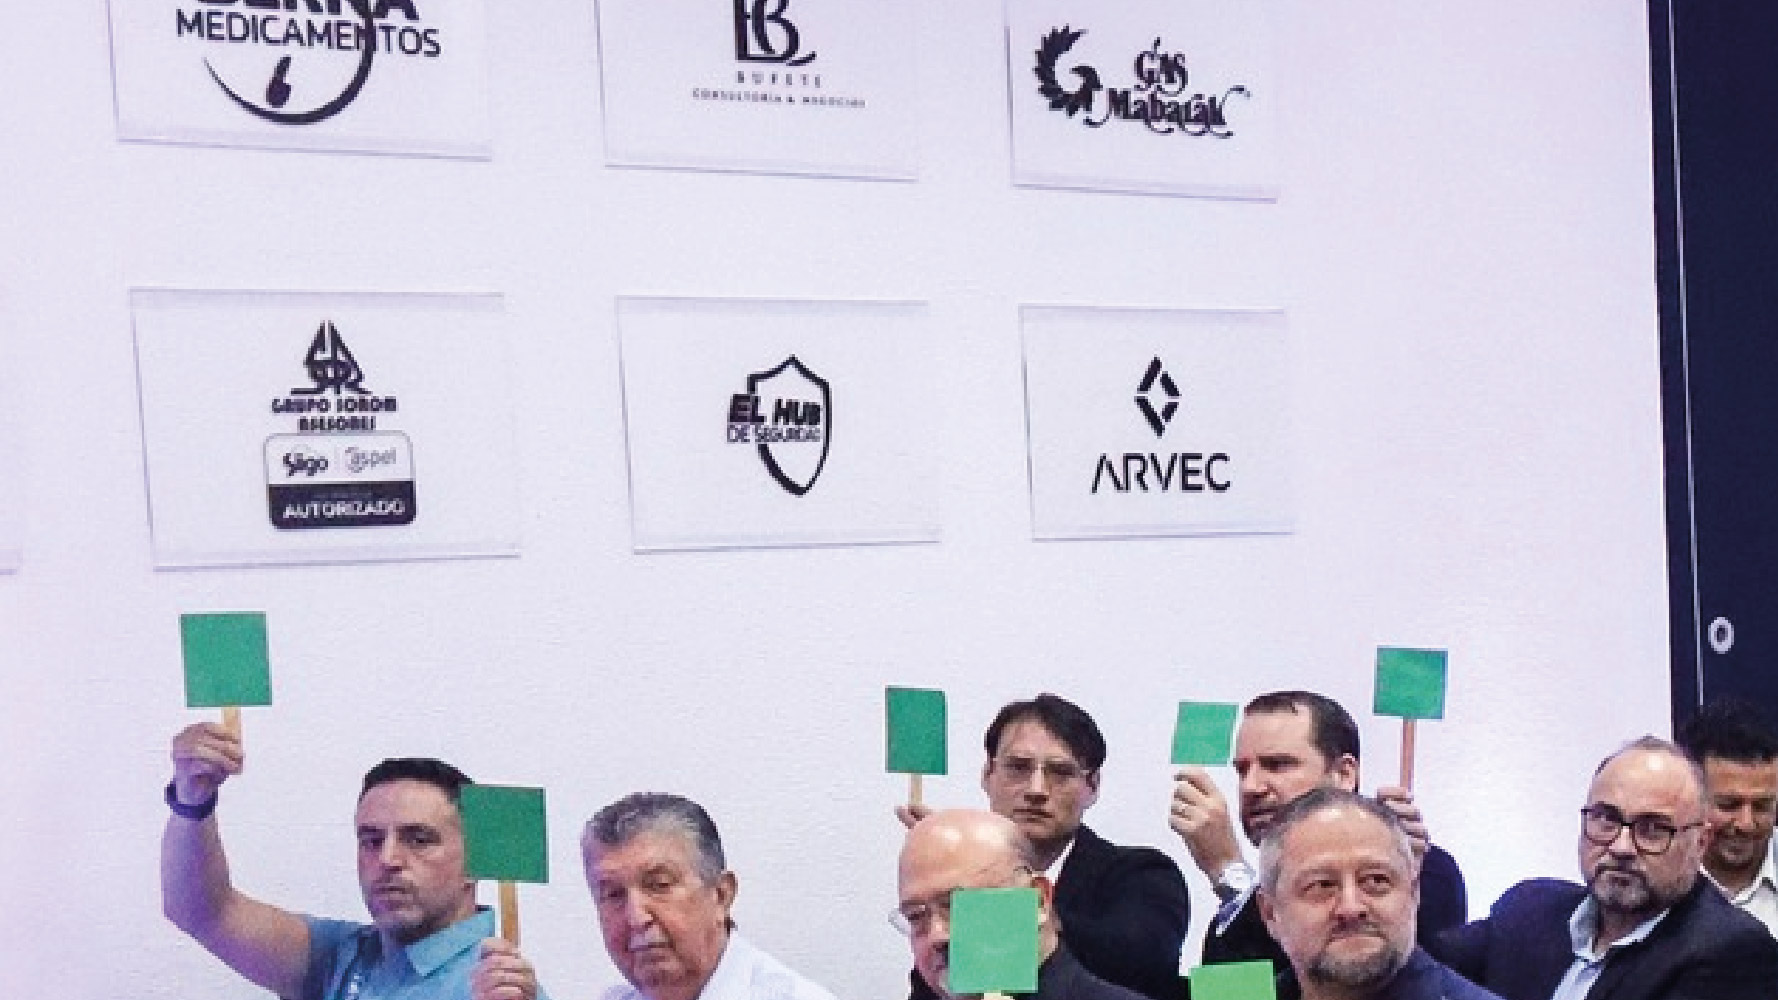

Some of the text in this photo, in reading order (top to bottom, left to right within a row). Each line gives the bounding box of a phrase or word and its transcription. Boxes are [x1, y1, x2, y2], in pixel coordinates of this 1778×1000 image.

[176, 9, 441, 57] MEDICAMENTOS
[730, 394, 822, 426] EL HUB
[1090, 452, 1231, 494] ARVEC
[282, 498, 406, 519] AUTORIZADO
